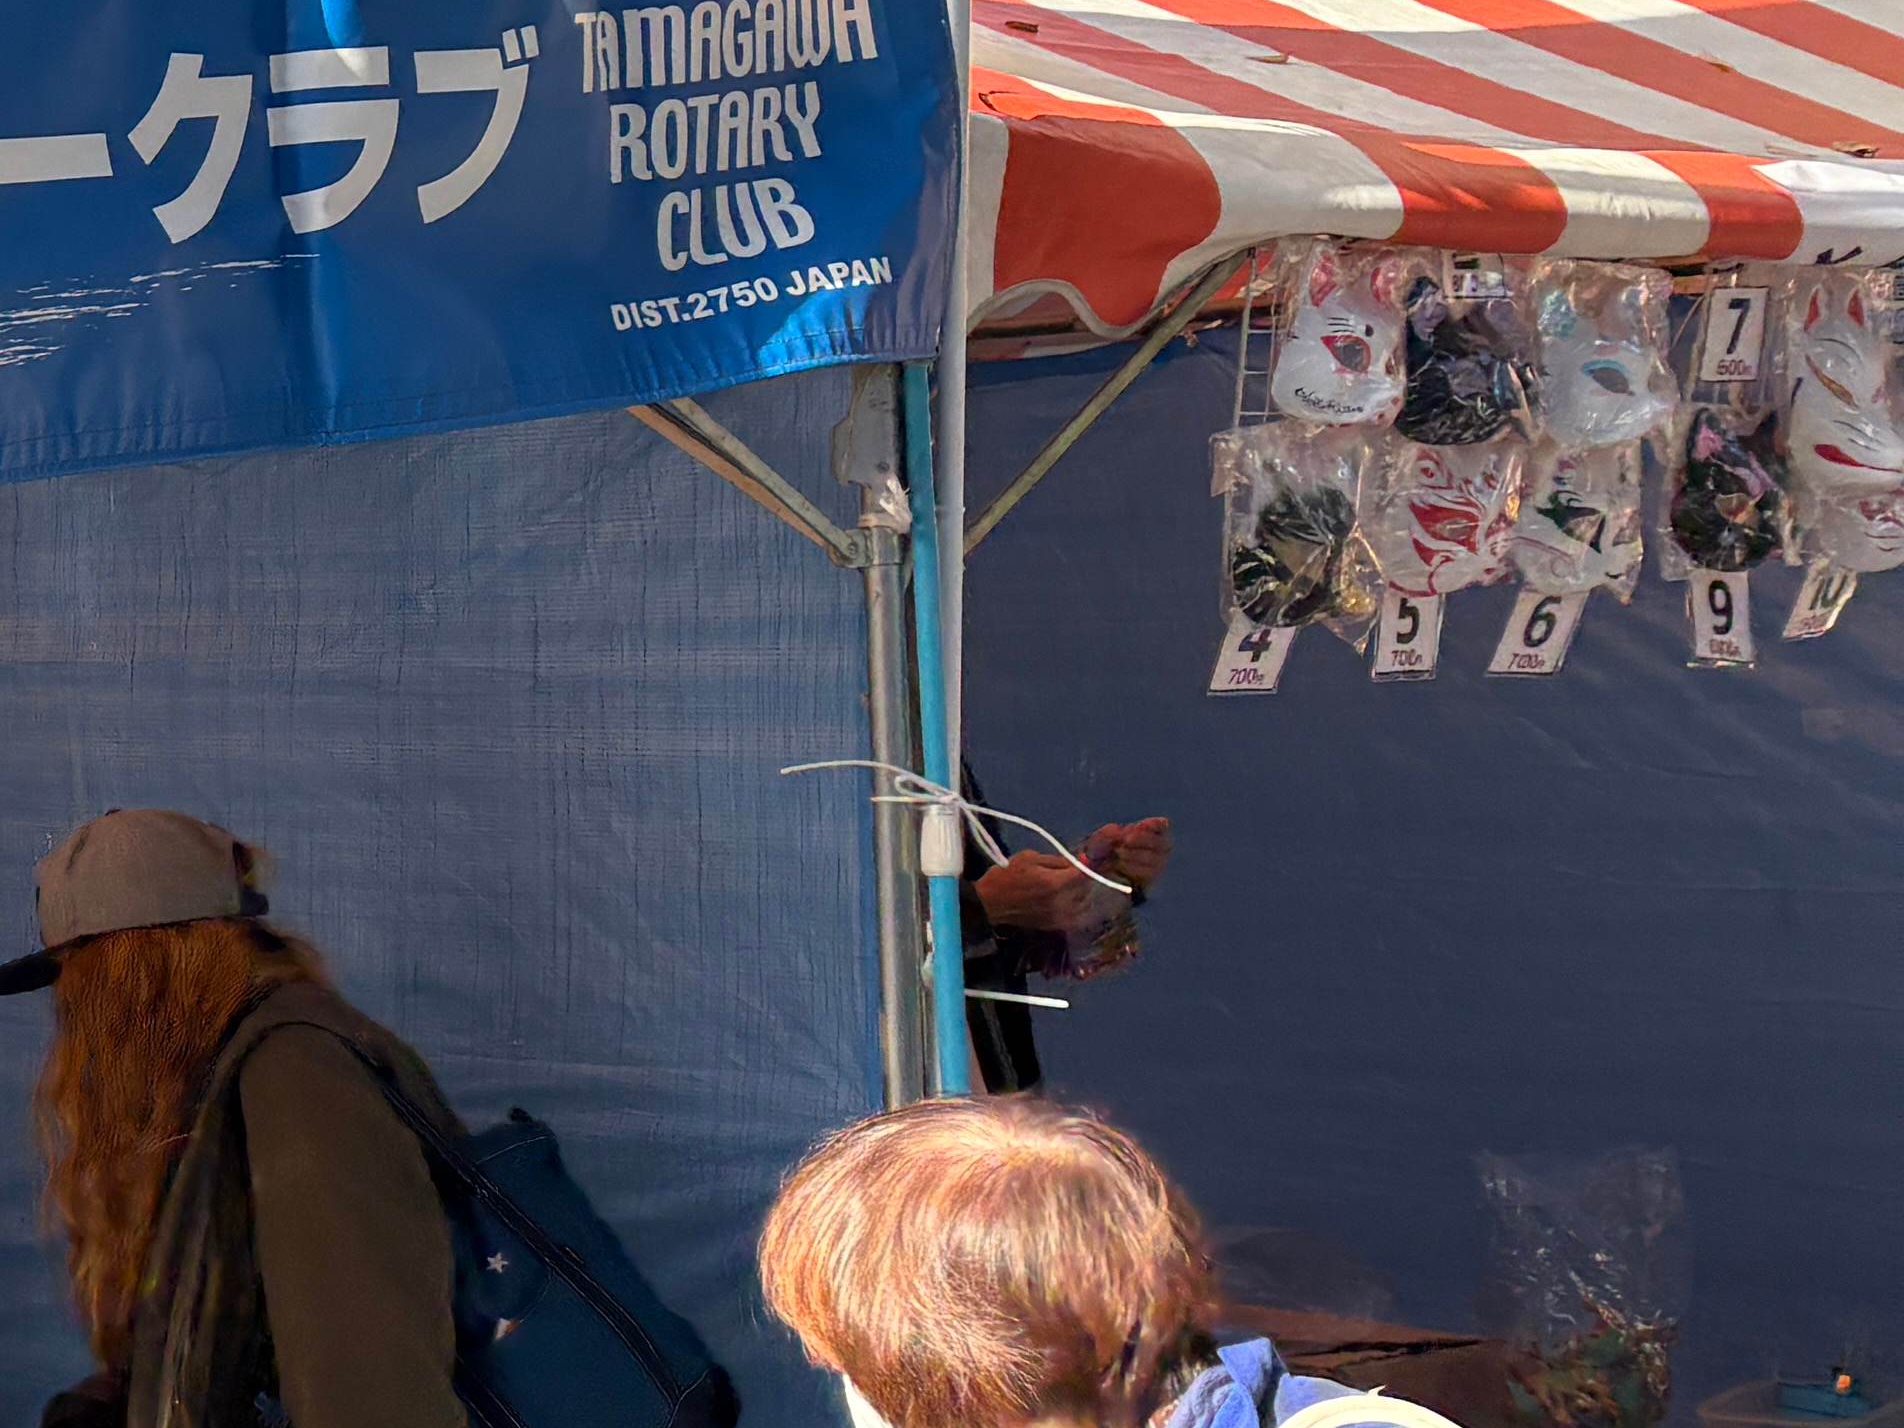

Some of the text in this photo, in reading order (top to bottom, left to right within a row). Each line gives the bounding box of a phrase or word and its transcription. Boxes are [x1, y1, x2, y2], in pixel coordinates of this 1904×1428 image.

[609, 81, 822, 183] ROTARY
[657, 178, 815, 271] CLUB
[787, 256, 893, 298] JAPAN
[1728, 298, 1750, 354] 7
[1397, 597, 1420, 644] 5
[1523, 596, 1562, 647] 6
[1708, 580, 1733, 635] 9
[1238, 629, 1272, 662] 4
